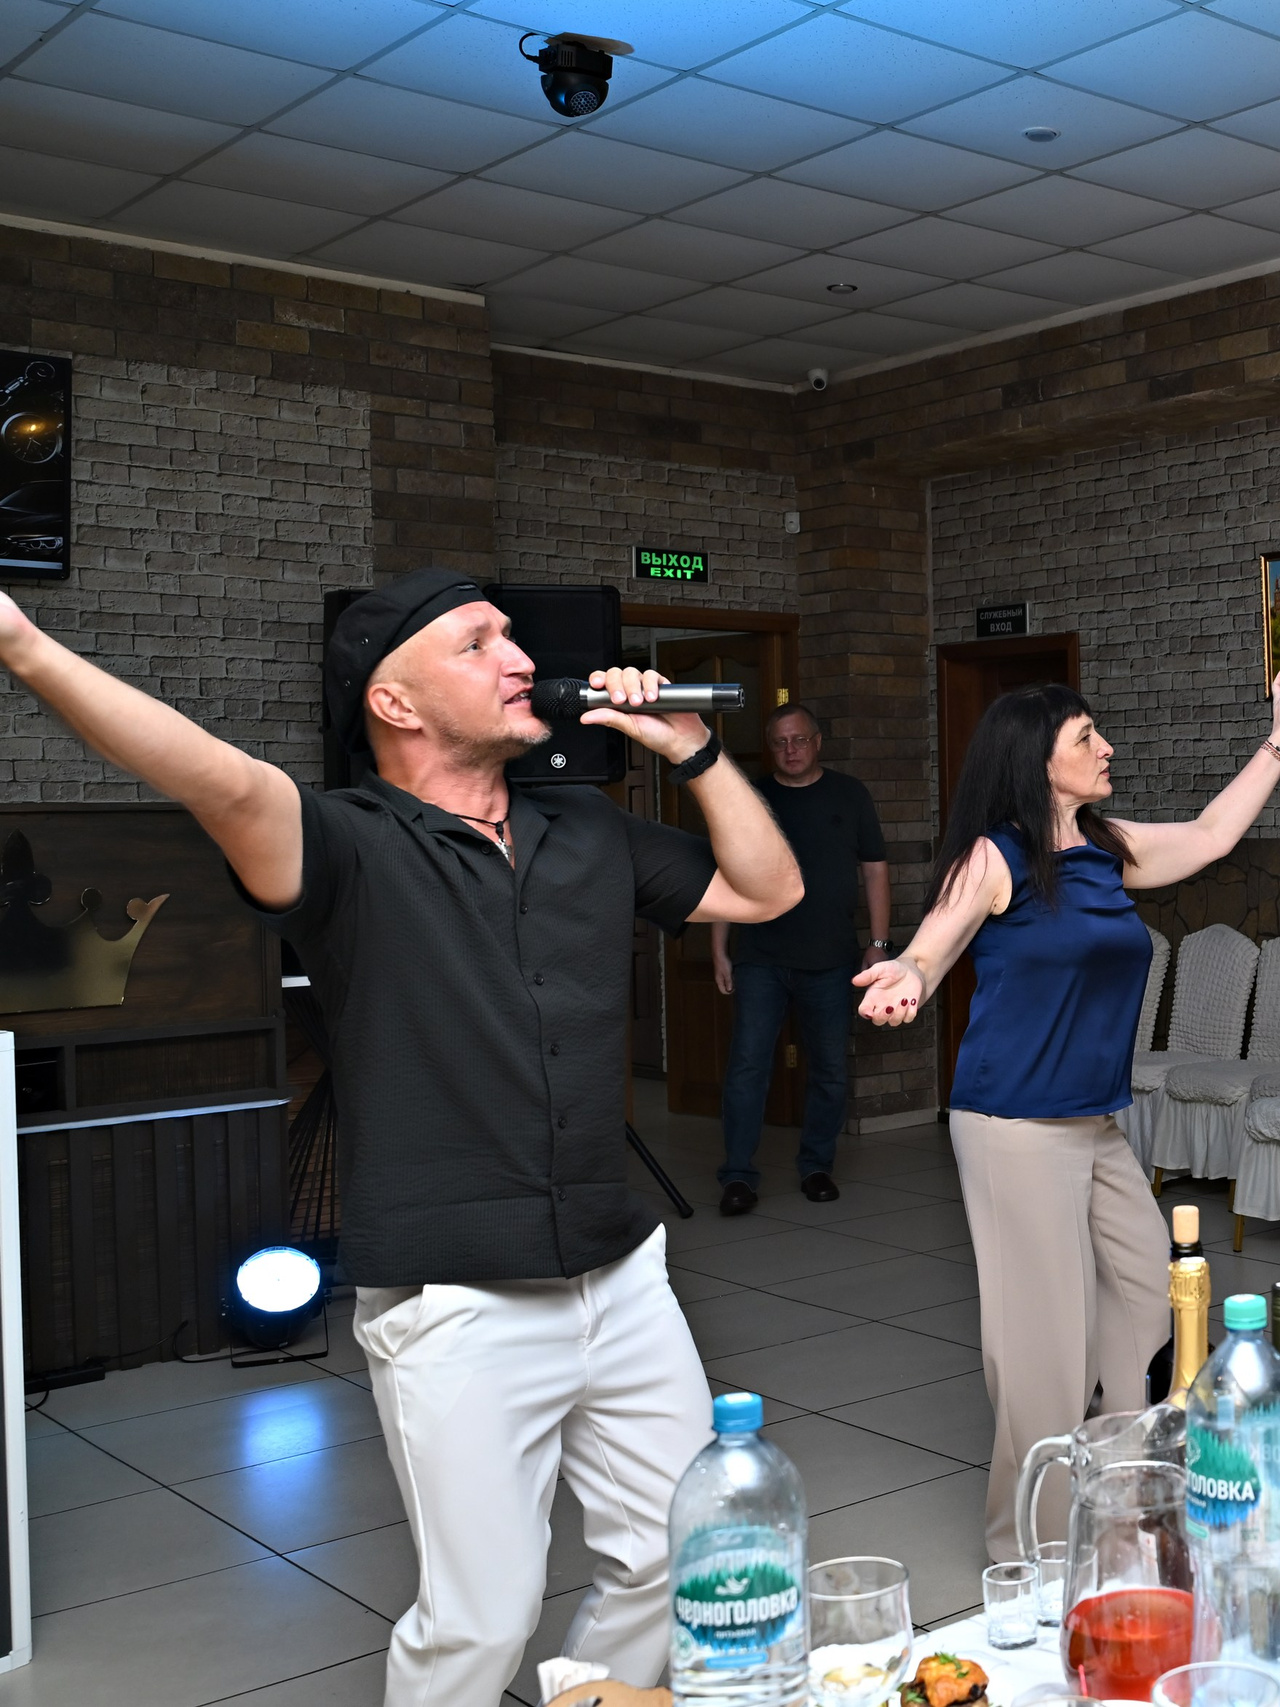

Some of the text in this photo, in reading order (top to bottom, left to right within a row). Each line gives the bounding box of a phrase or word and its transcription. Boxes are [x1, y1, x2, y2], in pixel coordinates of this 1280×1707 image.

[641, 552, 703, 571] ВЫХОД
[650, 567, 694, 579] EXIT
[980, 607, 1023, 620] СЛУЖЕБНЫЙ
[990, 621, 1012, 632] ВХОД
